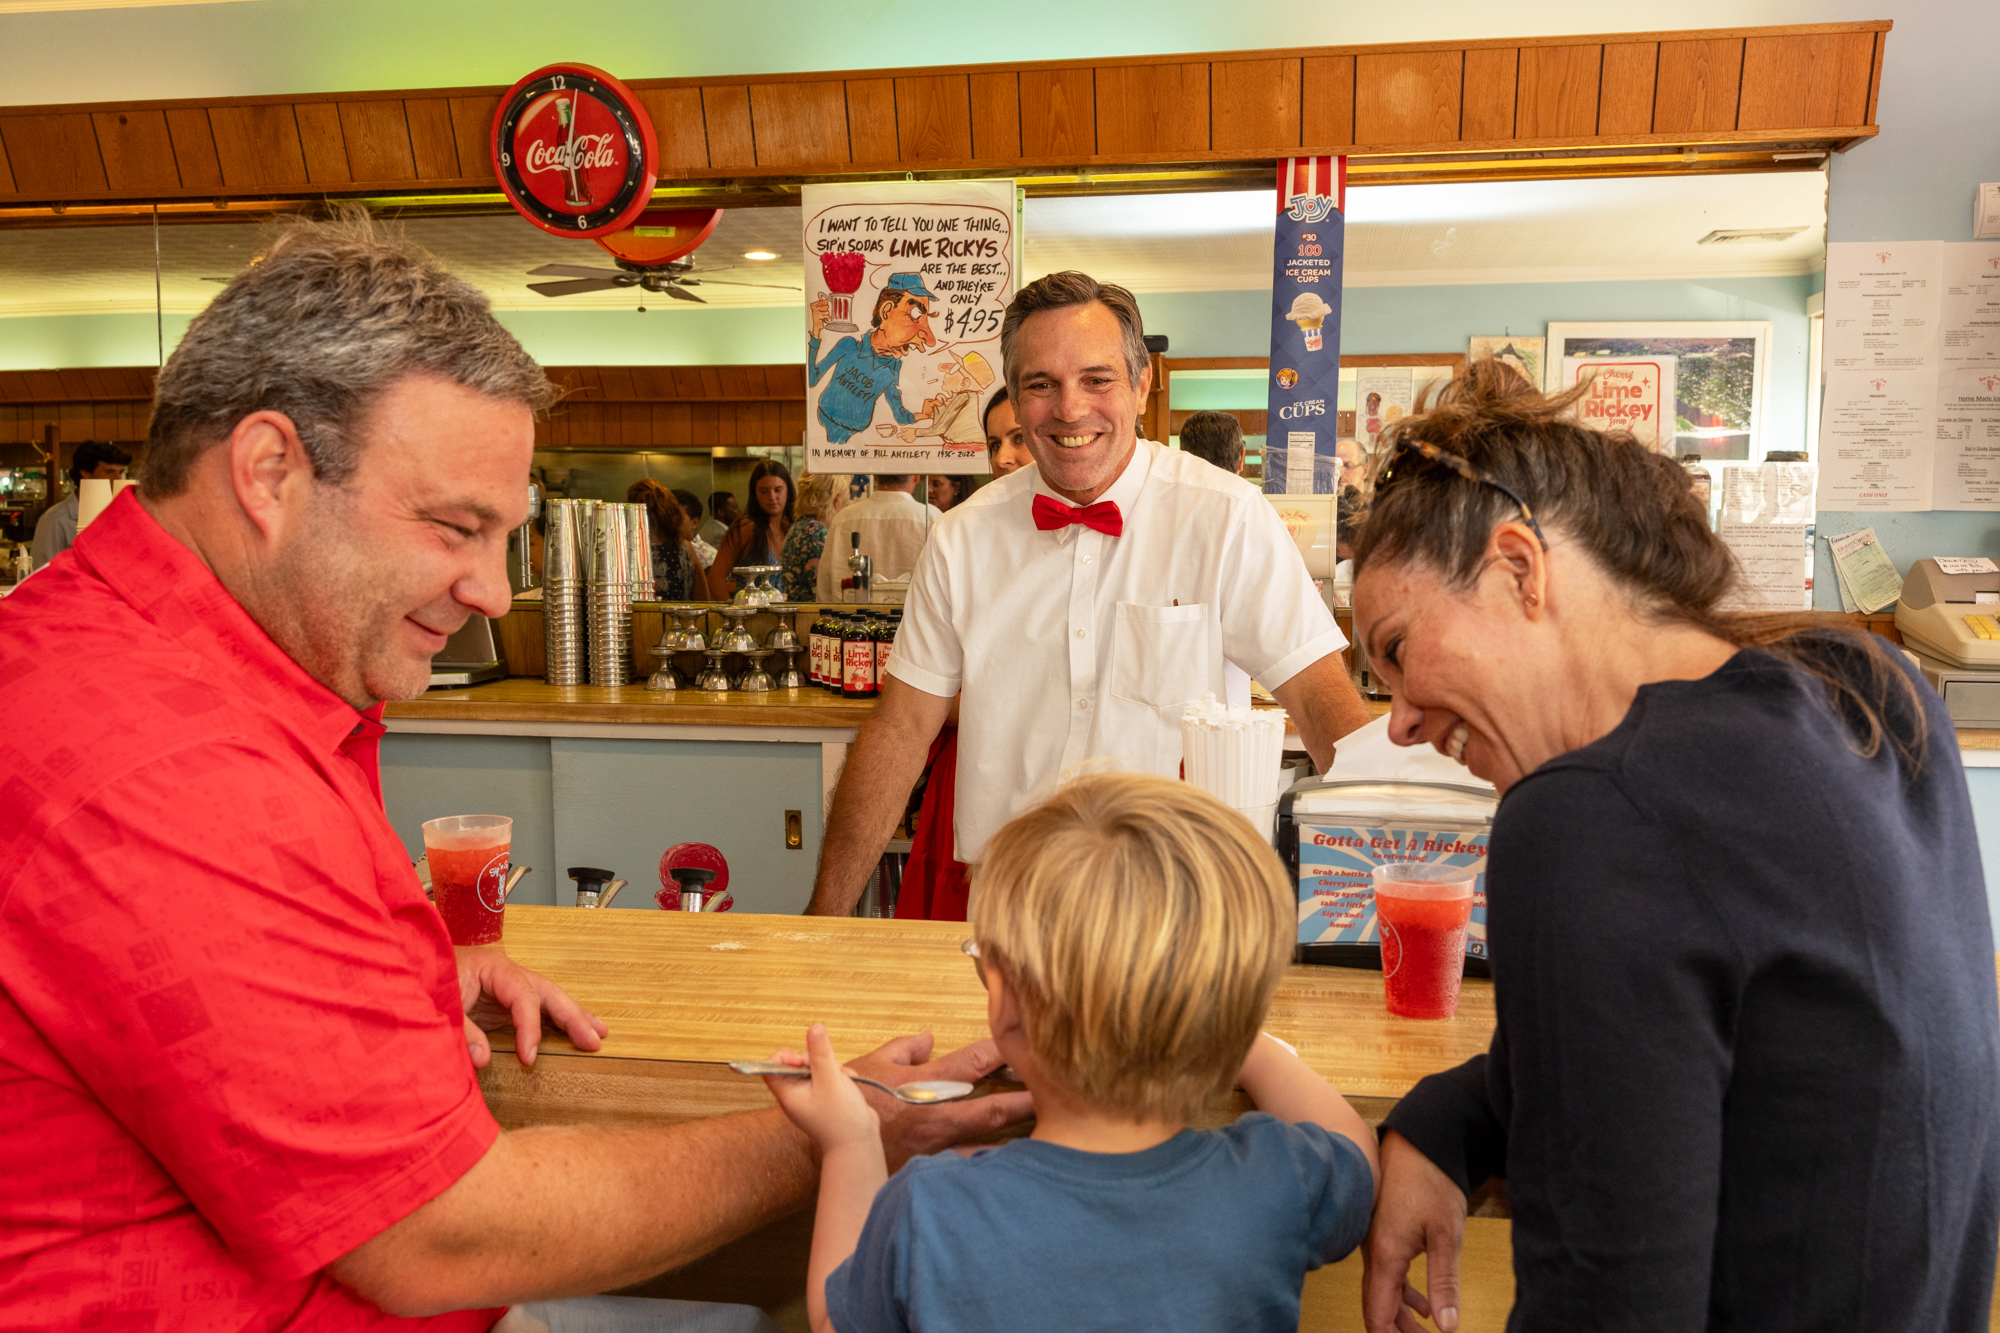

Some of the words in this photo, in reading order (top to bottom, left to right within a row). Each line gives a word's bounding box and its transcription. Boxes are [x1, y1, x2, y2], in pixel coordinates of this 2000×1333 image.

[550, 75, 566, 91] 12
[526, 133, 615, 174] CocaCola
[501, 154, 511, 167] 9
[577, 215, 588, 230] 6
[819, 218, 826, 233] I
[827, 217, 862, 233] WANT
[864, 218, 878, 232] TO
[880, 216, 908, 233] TELL
[912, 217, 934, 232] YOU
[936, 218, 960, 233] ONE
[963, 217, 1009, 235] THING...
[1301, 233, 1317, 242] #30
[816, 236, 845, 252] SIP'N
[847, 239, 884, 253] SODAS
[889, 237, 933, 259] LIME
[935, 237, 999, 259] RICKYS
[1298, 244, 1322, 257] 100
[919, 263, 942, 275] ARE
[946, 263, 967, 275] THE
[970, 262, 1007, 277] BEST...
[1286, 259, 1331, 267] JACKETED
[1297, 275, 1320, 283] CUPS
[933, 279, 954, 292] AND
[956, 278, 997, 294] THEY'RE
[950, 293, 983, 306] ONLY
[944, 306, 1004, 338] $4.95
[844, 365, 876, 389] JACOB
[1603, 368, 1634, 382] Cherry
[835, 374, 877, 404] ANTILETY
[1591, 381, 1642, 400] Lime
[1279, 403, 1326, 420] CUPS
[1584, 402, 1653, 421] Rickey
[811, 448, 821, 457] IN
[824, 449, 856, 458] MEMORY
[860, 449, 869, 457] OF
[873, 449, 888, 457] BILL
[891, 450, 931, 460] ANTILETY
[848, 650, 870, 659] Lime
[845, 658, 873, 669] Rickey
[1313, 833, 1365, 848] Gotta
[1370, 837, 1402, 850] Get
[1405, 838, 1418, 851] A
[1422, 839, 1489, 858] Rickey
[1383, 853, 1429, 863] refreshing!
[1312, 868, 1332, 876] Grab
[1342, 869, 1365, 878] bottle
[1318, 879, 1347, 889] Cherry
[1348, 880, 1369, 889] Lime
[1313, 889, 1340, 899] Rickey
[1342, 892, 1365, 901] syrup
[1367, 892, 1374, 900] &
[1320, 900, 1340, 908] take
[1348, 901, 1366, 909] little
[1321, 910, 1343, 919] Sip'n
[1329, 921, 1357, 930] home!
